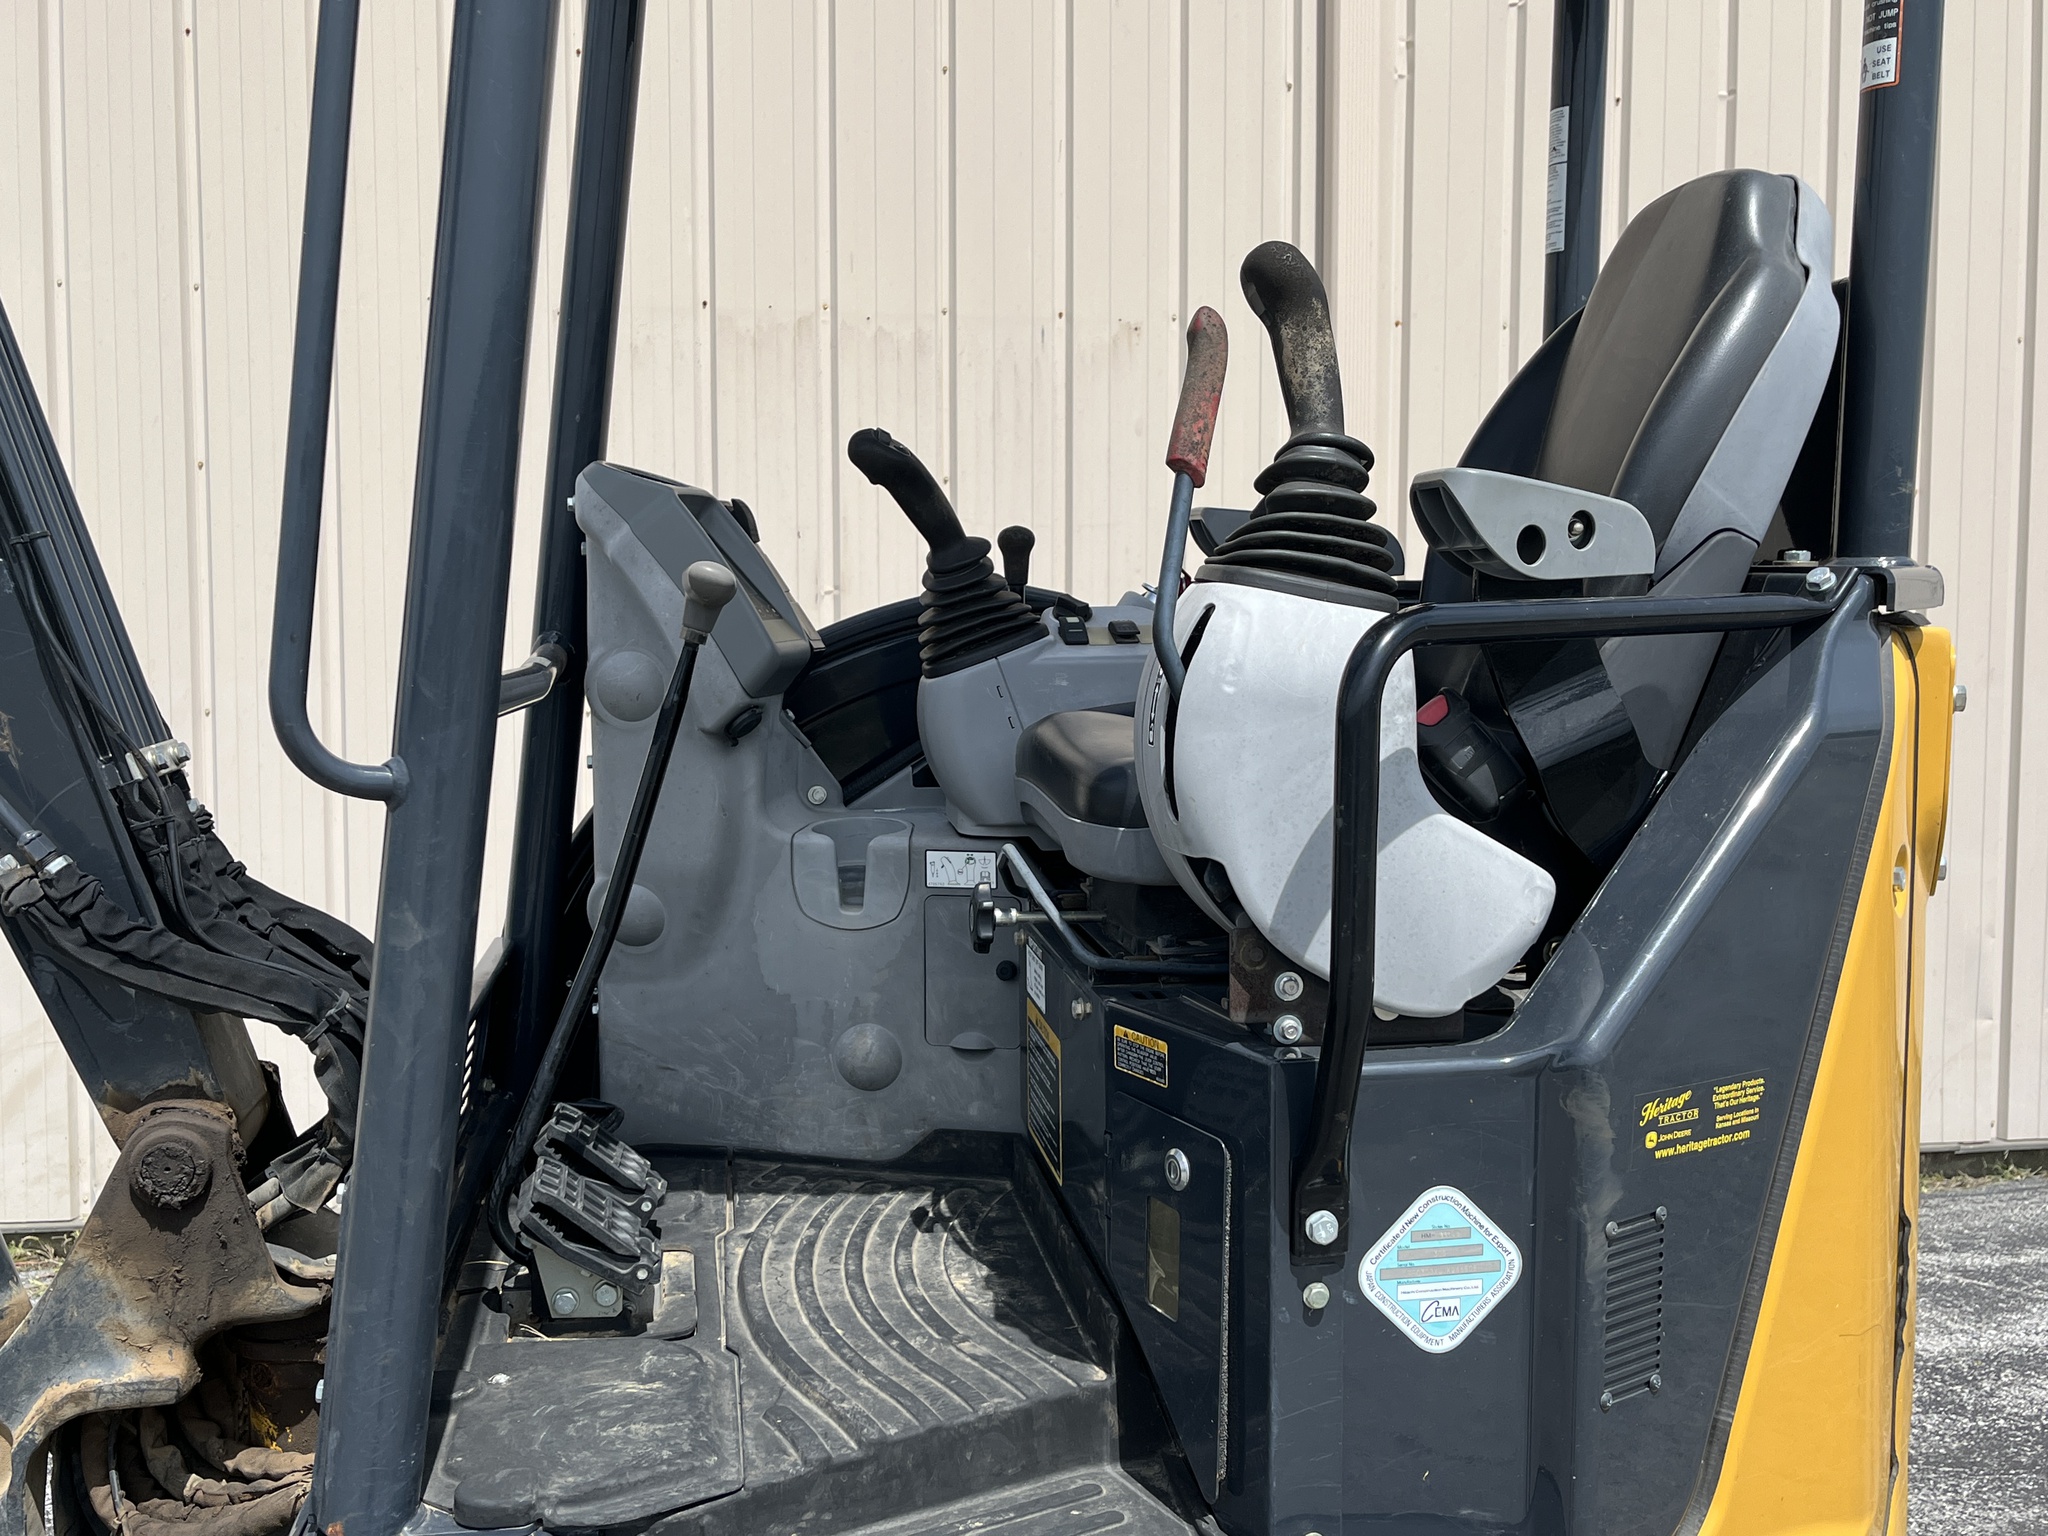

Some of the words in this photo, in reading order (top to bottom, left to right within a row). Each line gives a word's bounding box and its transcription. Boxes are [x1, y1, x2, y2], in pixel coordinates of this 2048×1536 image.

[1878, 8, 1899, 19] JUMP
[1884, 22, 1897, 30] tips
[1876, 44, 1892, 54] USE
[1872, 57, 1891, 68] SEAT
[1871, 70, 1890, 81] BELT
[1131, 1032, 1160, 1050] CAUTION
[1639, 1090, 1692, 1126] Heritage
[1658, 1109, 1699, 1125] TRACTOR
[1655, 1129, 1750, 1159] www.heritagetractor.com
[1658, 1133, 1673, 1142] JOHN
[1369, 1234, 1400, 1266] Certificate
[1399, 1225, 1407, 1234] of
[1404, 1212, 1420, 1227] New
[1418, 1194, 1466, 1214] Construction
[1461, 1205, 1485, 1231] Machine
[1483, 1227, 1493, 1239] for
[1490, 1236, 1512, 1258] Export
[1365, 1270, 1377, 1293] JAPAN
[1374, 1291, 1411, 1328] CONSTRUCTION
[1411, 1324, 1445, 1347] EQUIPMENT
[1448, 1296, 1492, 1342] MANUFACTURERS
[1490, 1258, 1515, 1299] ASSOCIATION
